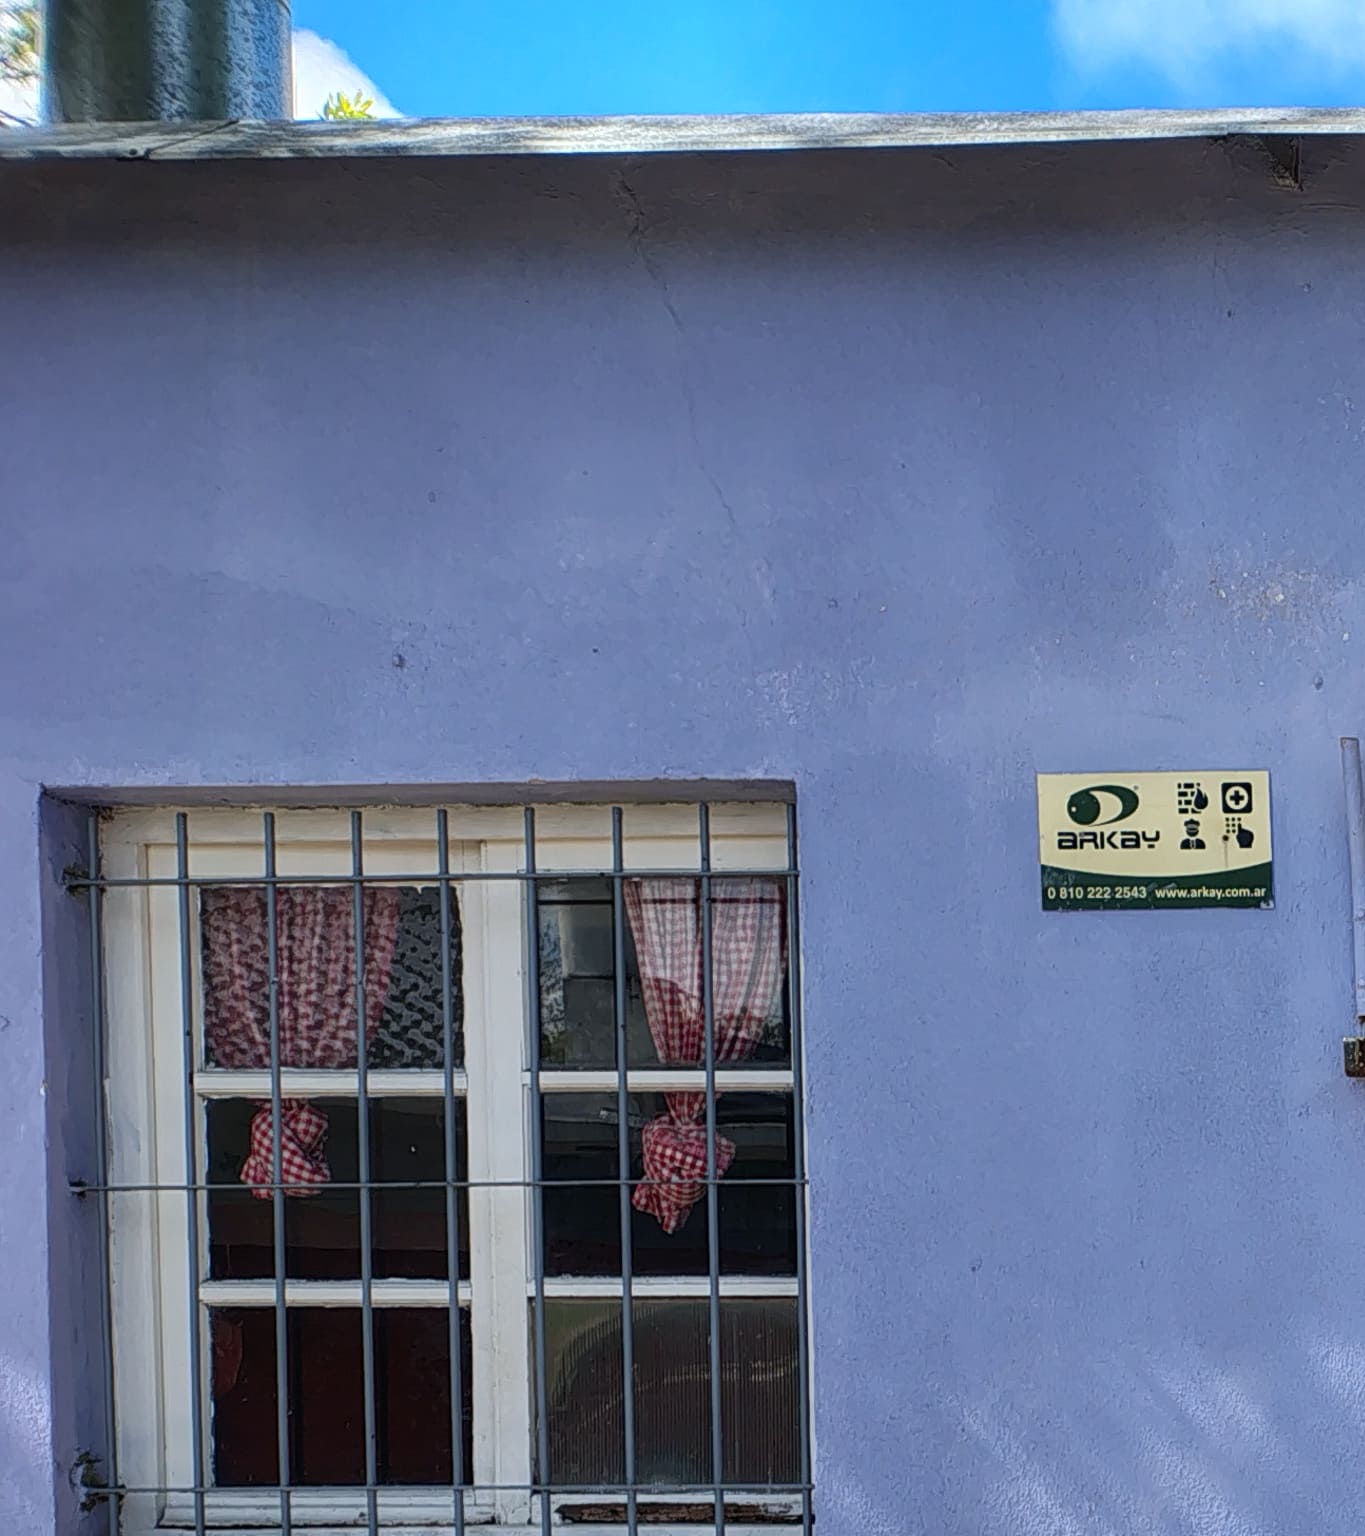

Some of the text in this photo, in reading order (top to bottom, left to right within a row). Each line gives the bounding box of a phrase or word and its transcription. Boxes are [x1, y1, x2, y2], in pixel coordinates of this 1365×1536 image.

[1047, 886, 1267, 900] 0 810 222 2543 www.arkay.com.ar
